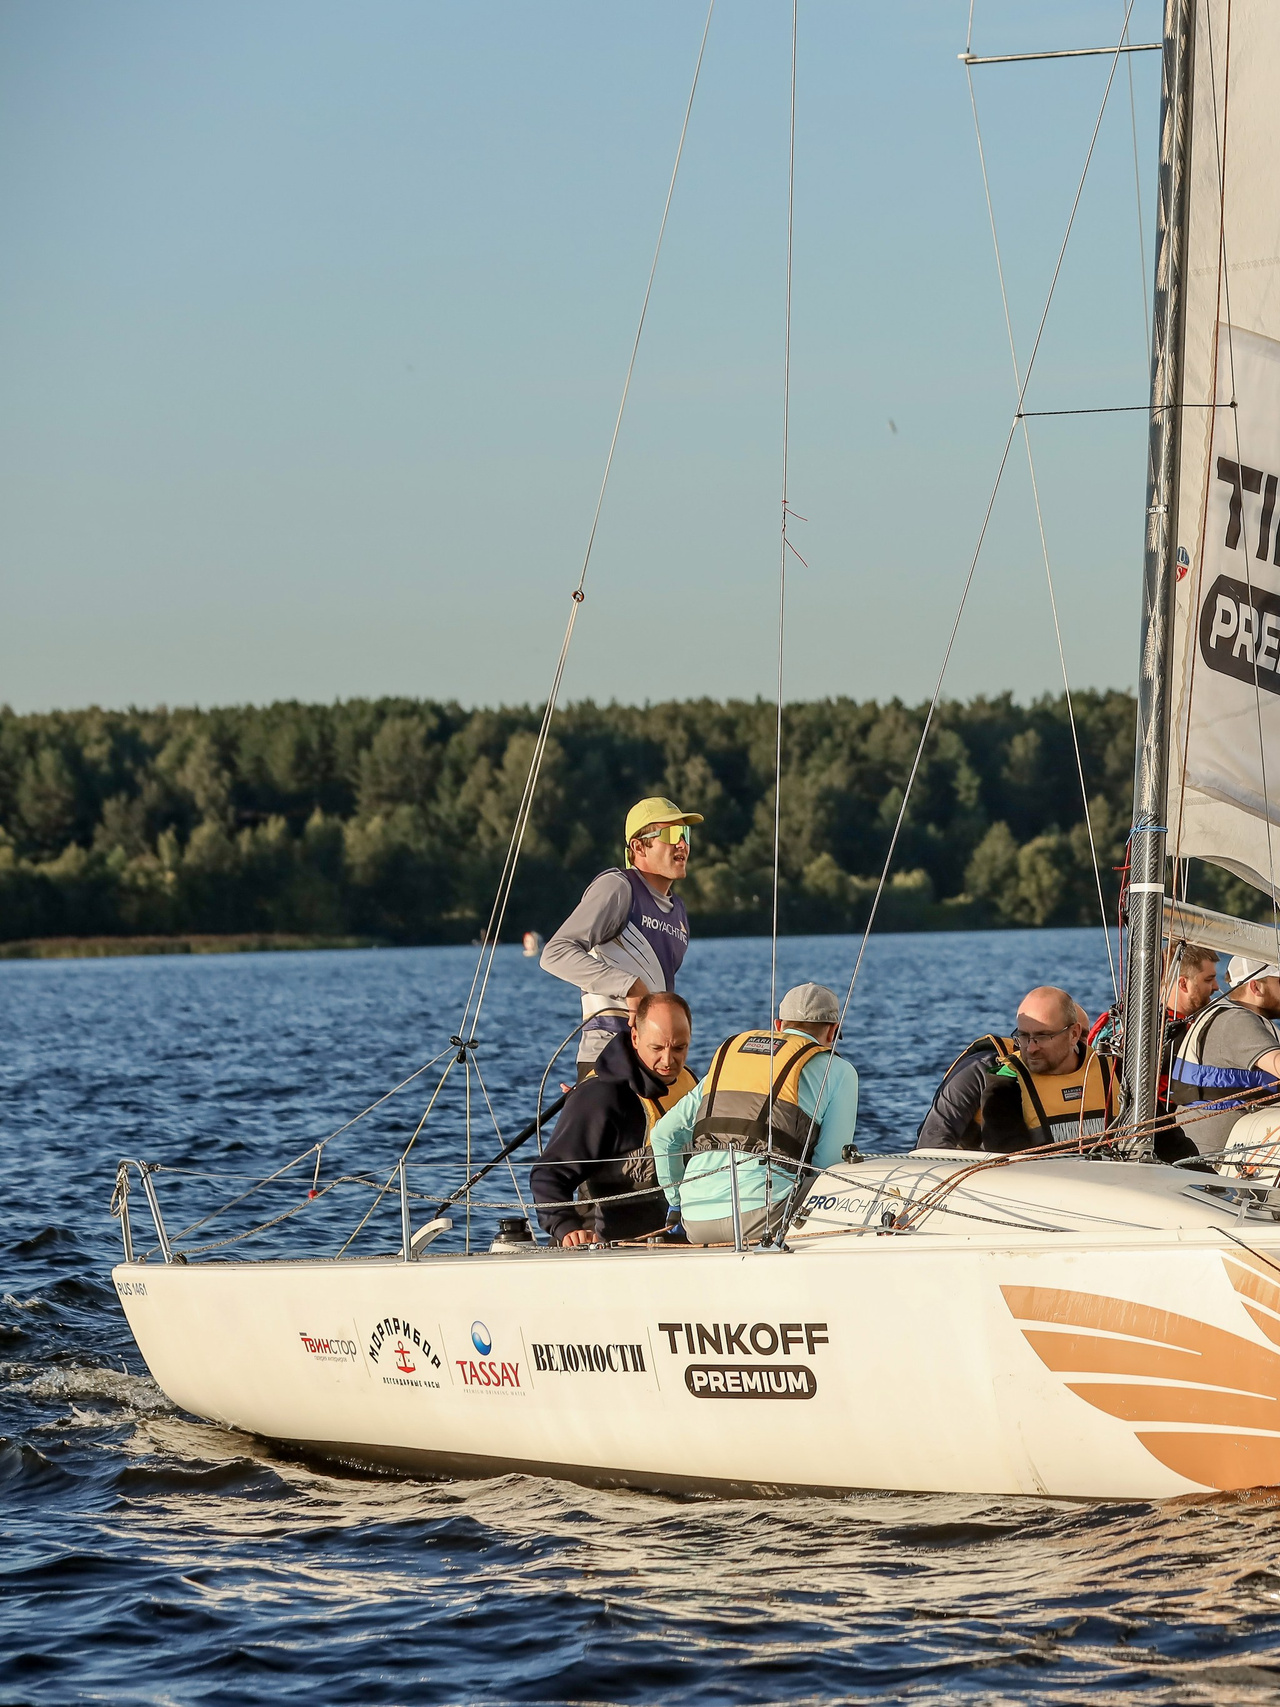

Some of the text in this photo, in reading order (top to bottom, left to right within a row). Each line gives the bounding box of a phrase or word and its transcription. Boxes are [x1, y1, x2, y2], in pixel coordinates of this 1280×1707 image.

[641, 914, 688, 946] PROYACHTING
[117, 1282, 132, 1295] RUS
[368, 1317, 442, 1369] МОРПРИБОР
[658, 1322, 830, 1355] TINKOFF
[455, 1360, 521, 1388] TASSAY
[531, 1342, 648, 1376] ВЕДОМОСТИ
[691, 1369, 811, 1394] PREMIUM
